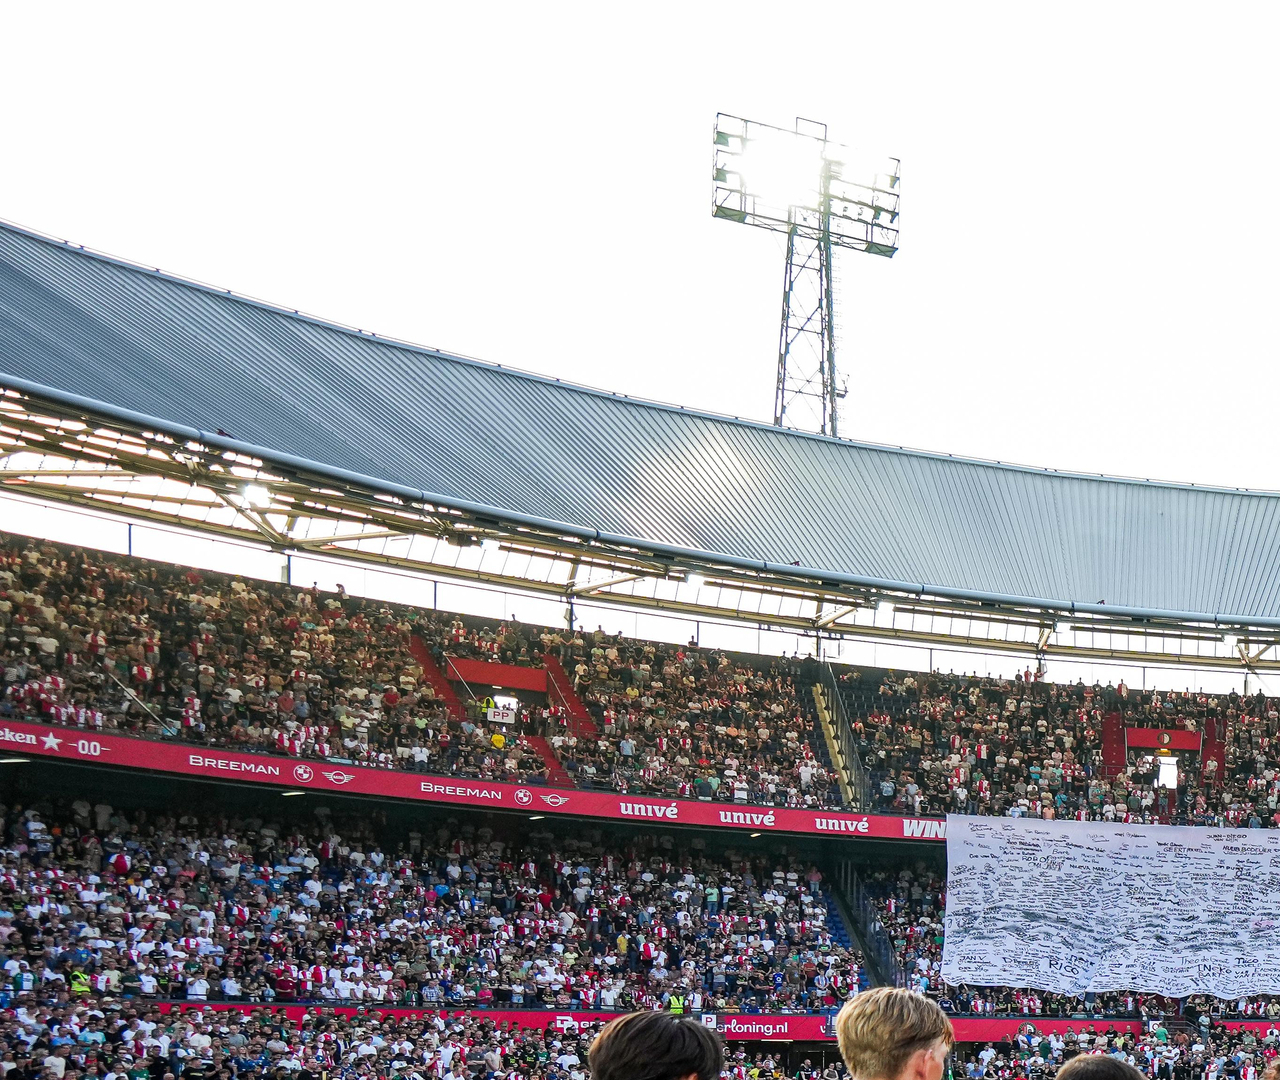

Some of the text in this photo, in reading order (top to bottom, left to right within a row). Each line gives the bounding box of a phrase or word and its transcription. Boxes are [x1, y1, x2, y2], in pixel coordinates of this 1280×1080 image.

[493, 711, 509, 720] PP
[189, 755, 280, 775] BREEMAN
[421, 782, 501, 799] BREEMAN
[620, 801, 678, 819] univé
[719, 810, 776, 827] univé
[815, 816, 869, 833] univé
[903, 819, 946, 838] WIN
[1049, 960, 1078, 975] RICO
[705, 1017, 713, 1026] P
[717, 1019, 788, 1035] erloning.nl
